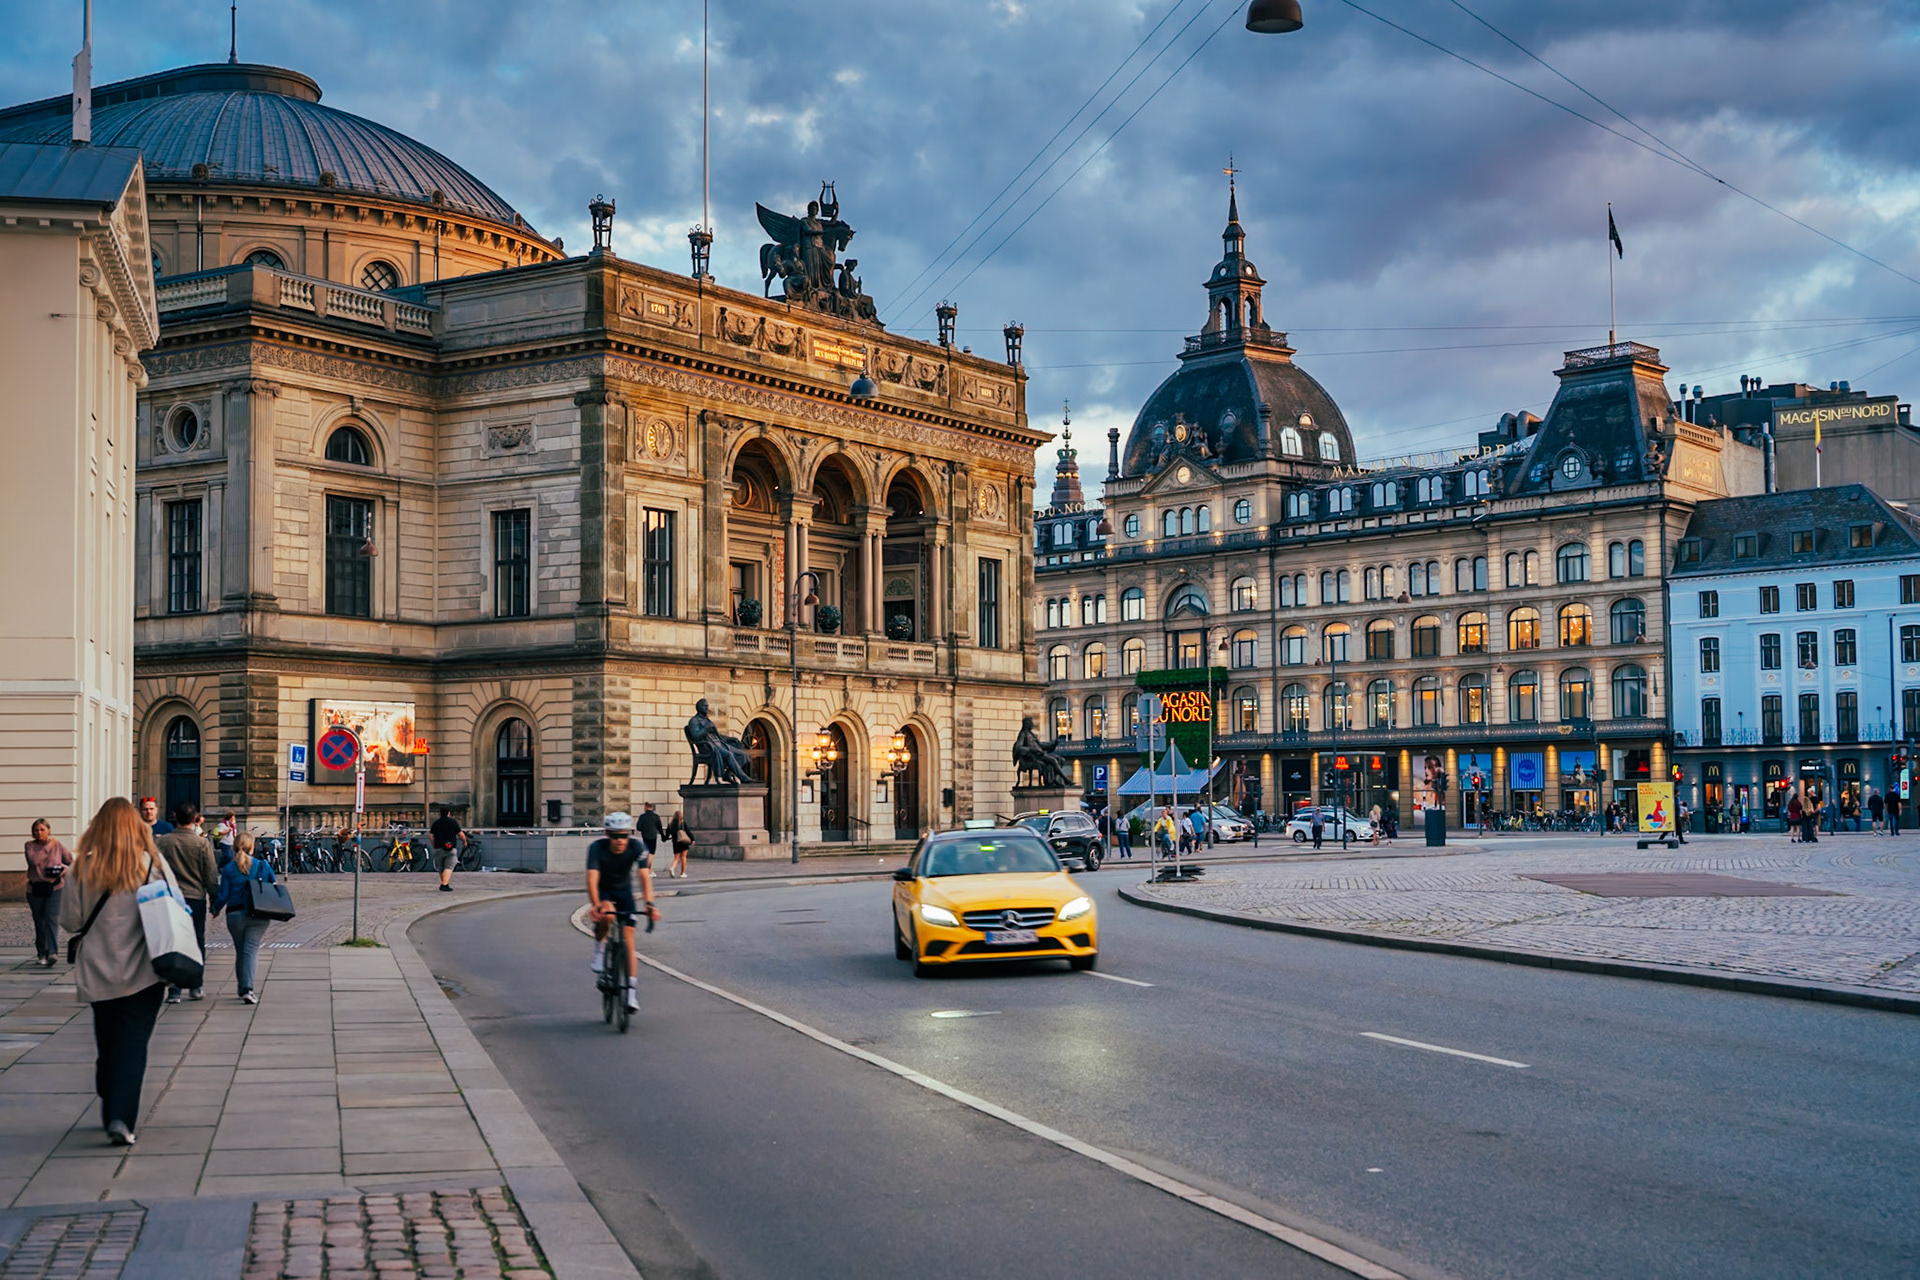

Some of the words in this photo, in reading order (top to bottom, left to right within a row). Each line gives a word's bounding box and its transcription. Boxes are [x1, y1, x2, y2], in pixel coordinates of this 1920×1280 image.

[1780, 409, 1841, 425] MAGASIN
[1841, 407, 1852, 416] DU
[1852, 404, 1890, 419] NORD
[1156, 690, 1211, 707] AGASIN
[1171, 706, 1212, 722] NORD
[1096, 767, 1105, 780] P
